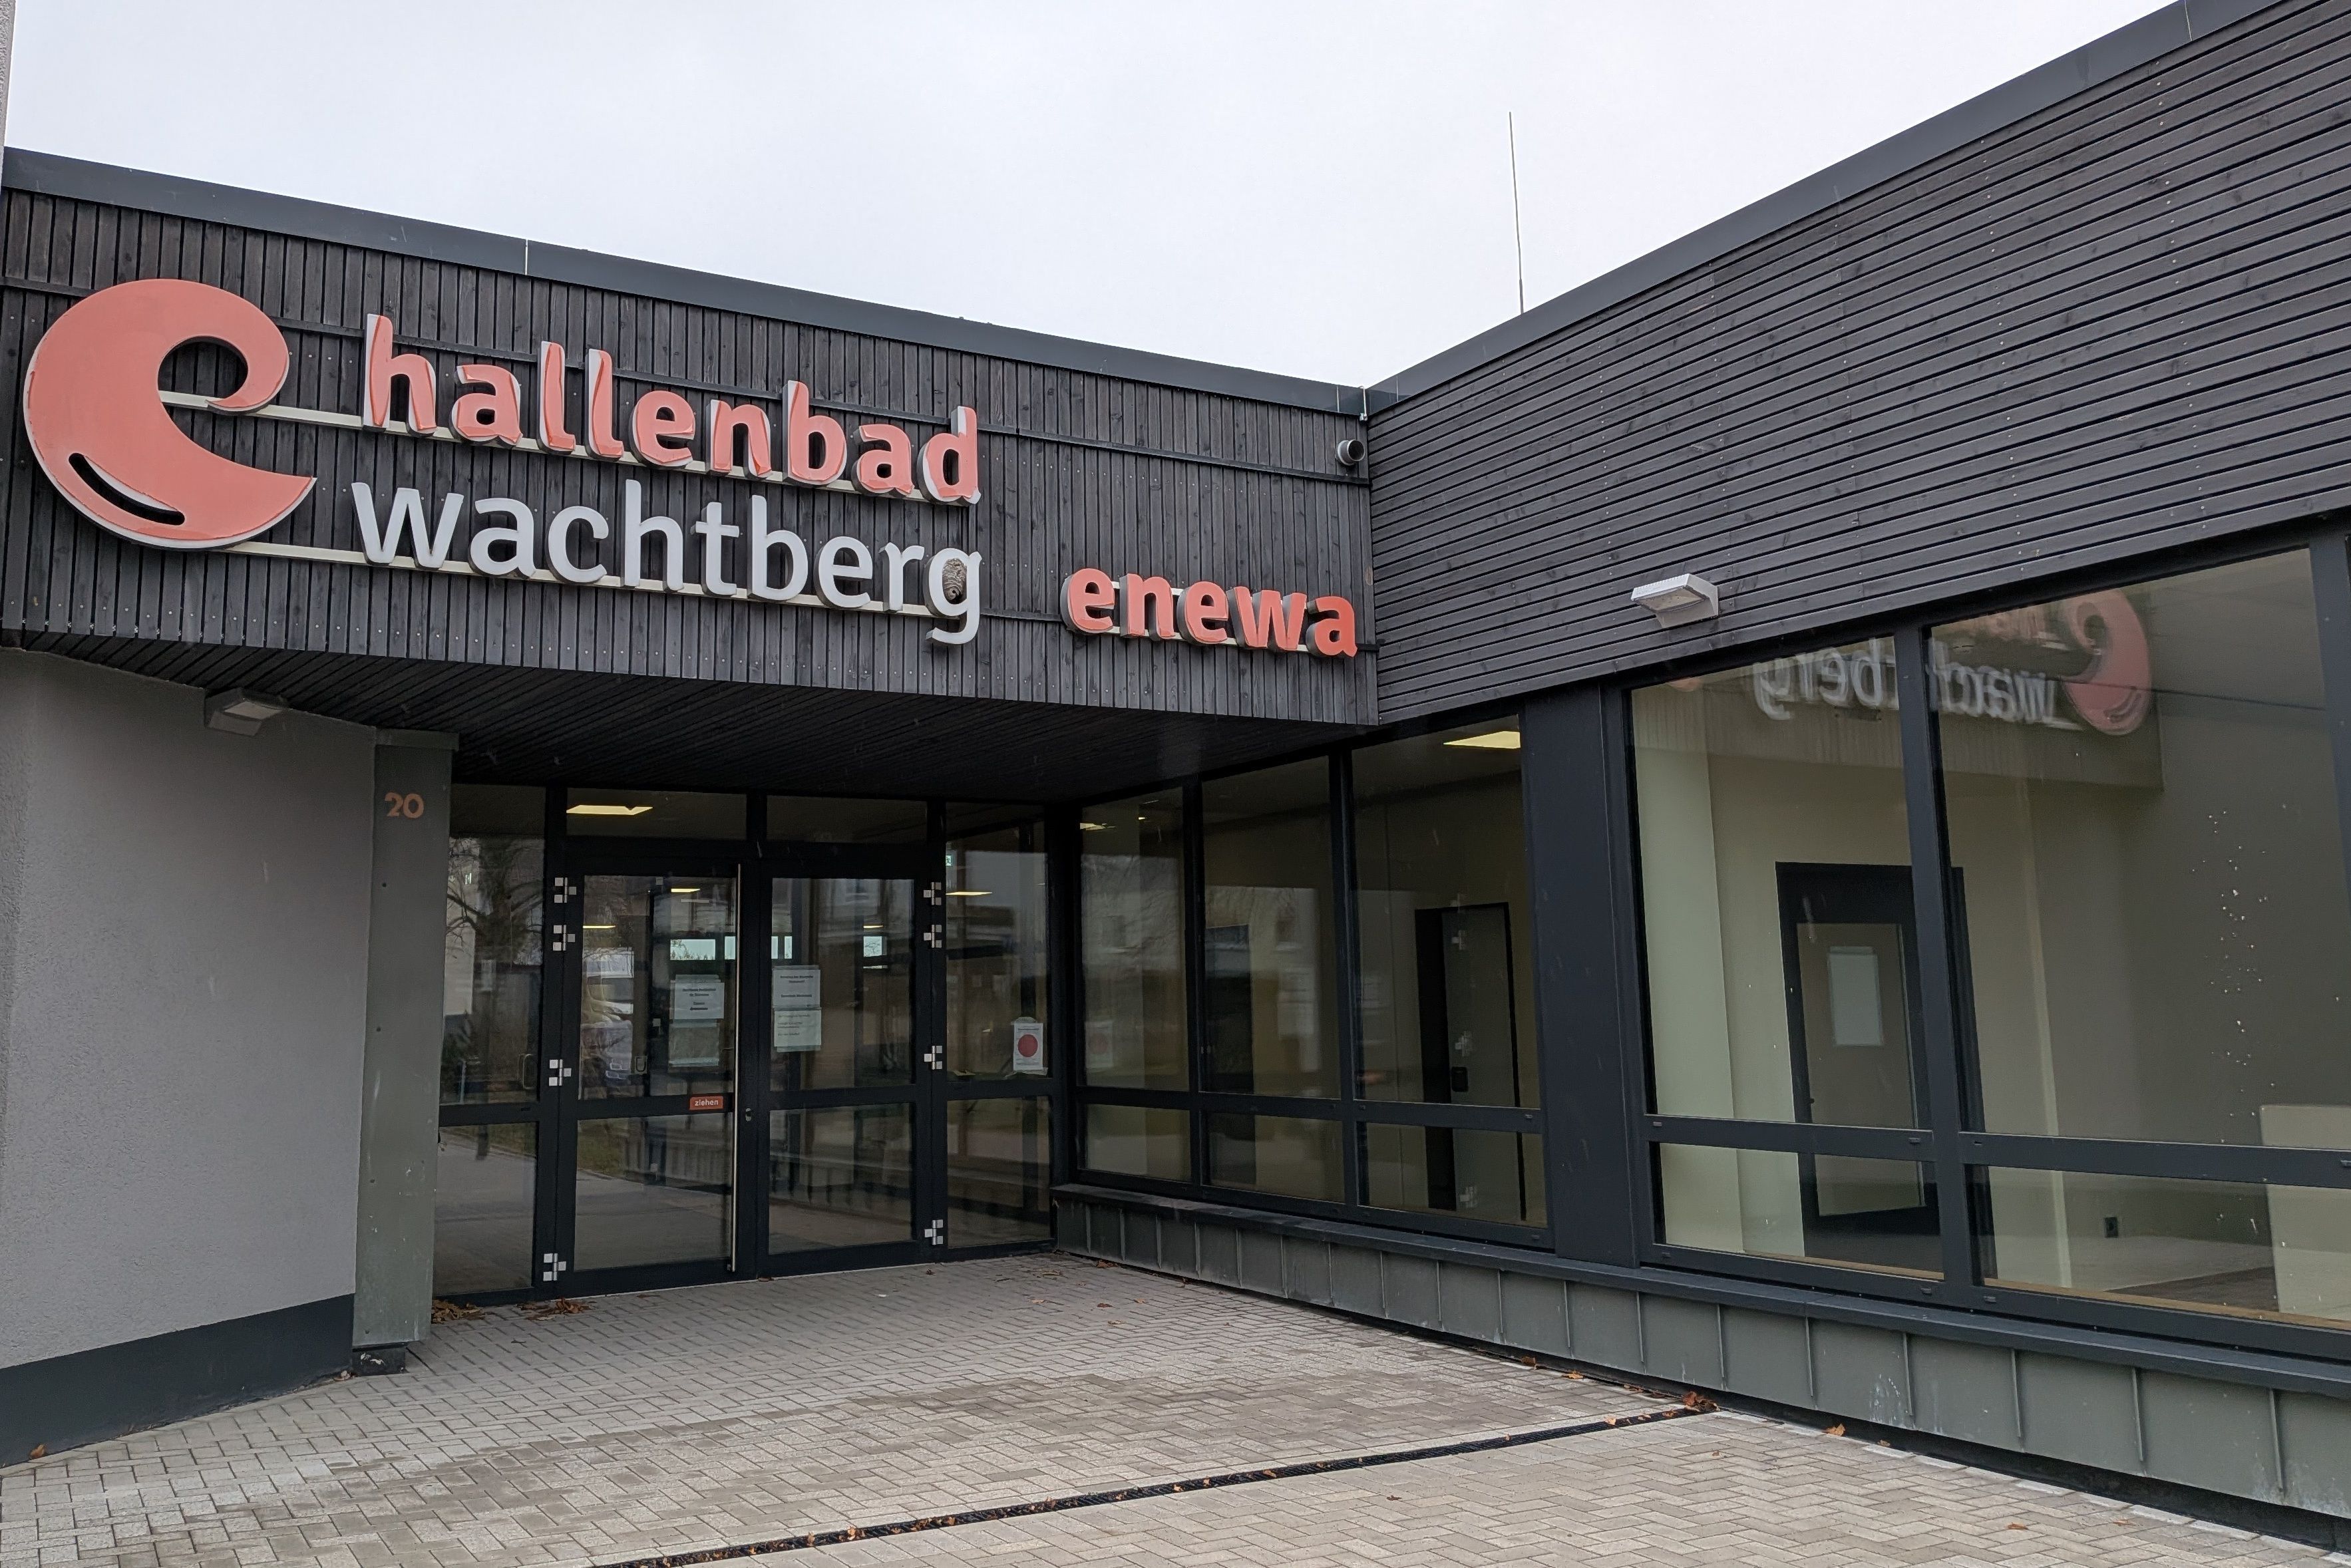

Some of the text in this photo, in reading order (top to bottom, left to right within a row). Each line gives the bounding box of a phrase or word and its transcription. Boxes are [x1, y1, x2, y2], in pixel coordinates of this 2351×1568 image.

[363, 313, 981, 505] hallenbad
[351, 477, 982, 647] wachtberg
[1062, 567, 1359, 659] enewa
[385, 792, 425, 819] 20
[694, 1098, 719, 1107] ziehen
